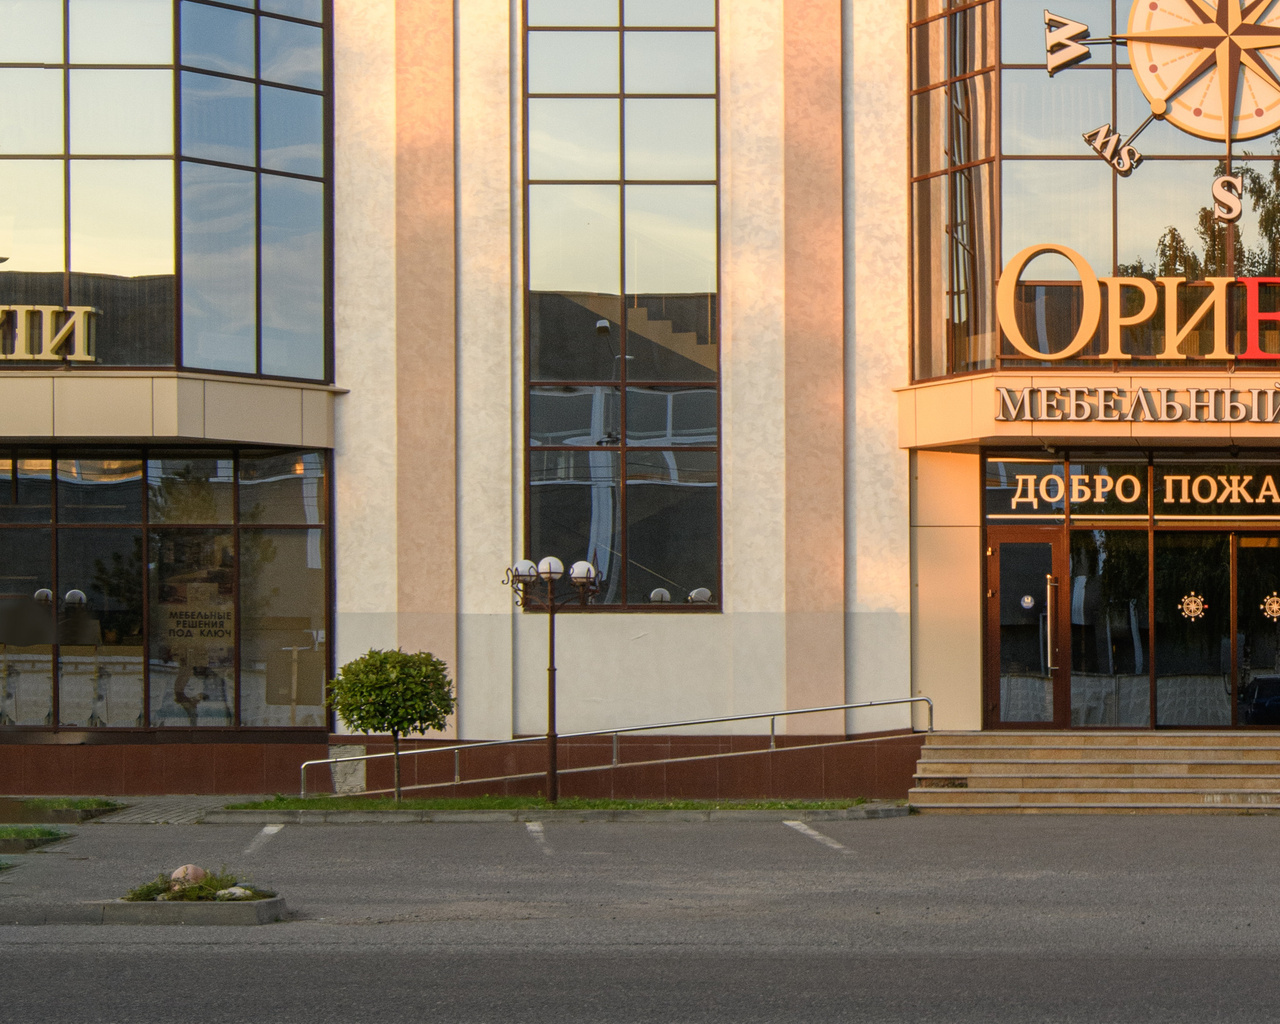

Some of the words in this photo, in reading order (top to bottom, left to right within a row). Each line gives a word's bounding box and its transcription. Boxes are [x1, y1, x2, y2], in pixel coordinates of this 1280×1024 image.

[1044, 9, 1089, 74] W
[1083, 123, 1140, 174] SW
[1211, 175, 1243, 222] S
[1011, 474, 1142, 510] ДОБРО
[168, 611, 232, 620] МЕБЕЛЬНЫЕ
[168, 628, 194, 637] ПОД
[200, 629, 232, 637] КЛЮЧ
[176, 620, 225, 628] РЕШЕНИЯ
